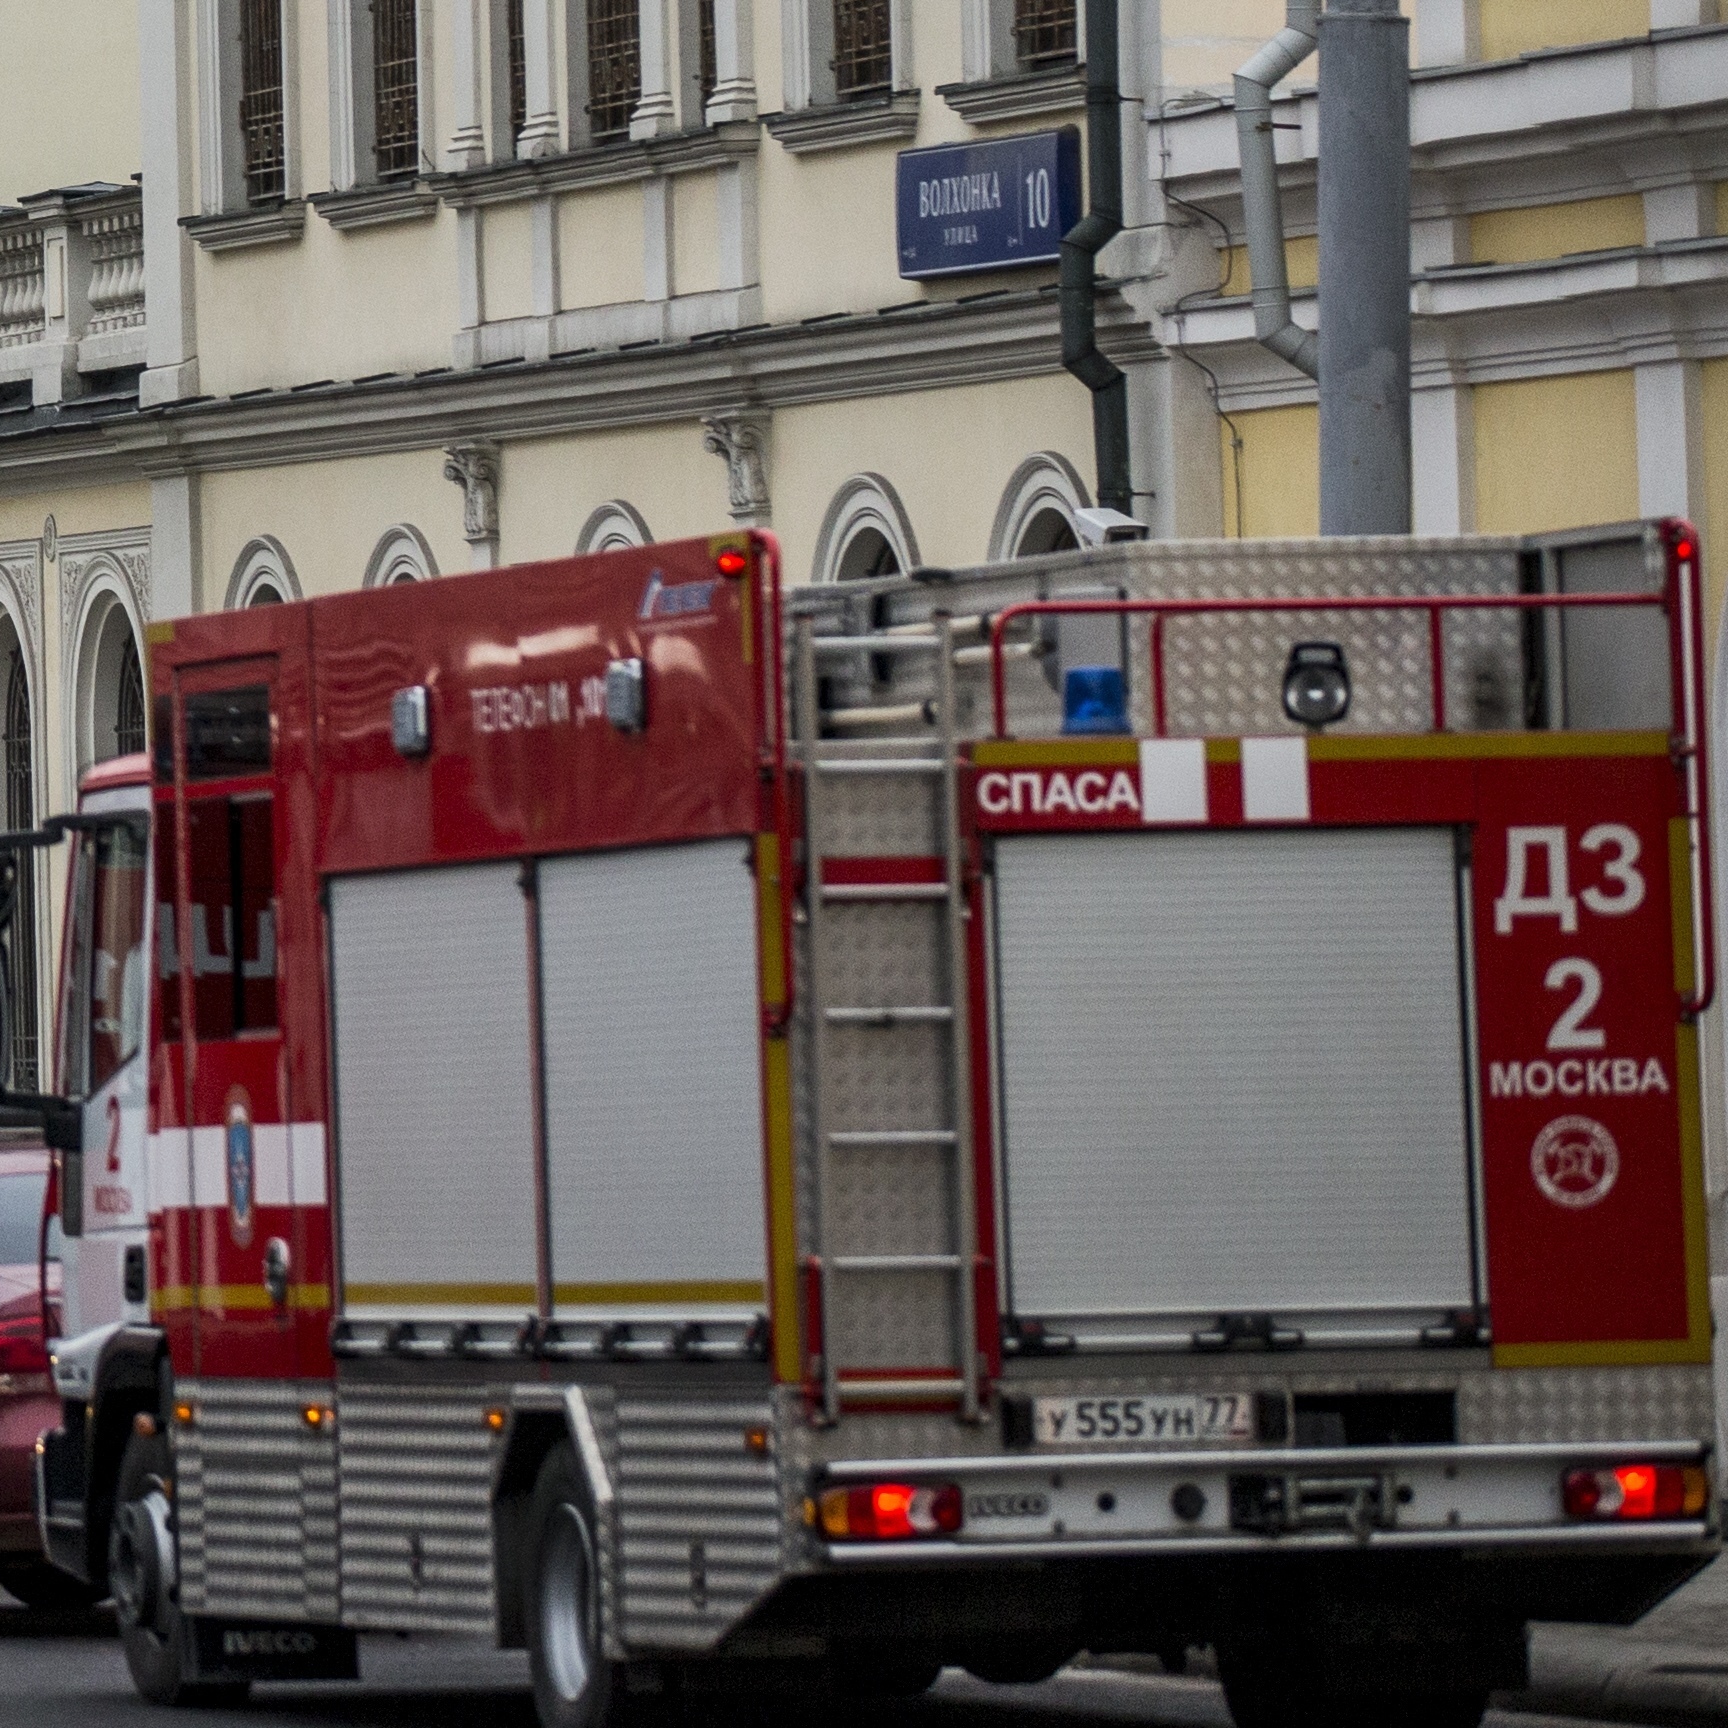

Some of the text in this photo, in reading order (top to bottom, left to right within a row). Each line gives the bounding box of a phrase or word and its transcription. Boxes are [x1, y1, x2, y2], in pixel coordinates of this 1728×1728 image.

[919, 172, 1002, 218] ВОЛХОНКА
[1025, 168, 1050, 229] 10
[977, 771, 1140, 814] СПАСА
[1545, 956, 1606, 1051] 2
[1489, 1057, 1670, 1098] МОСКВА
[1205, 1395, 1239, 1424] 77
